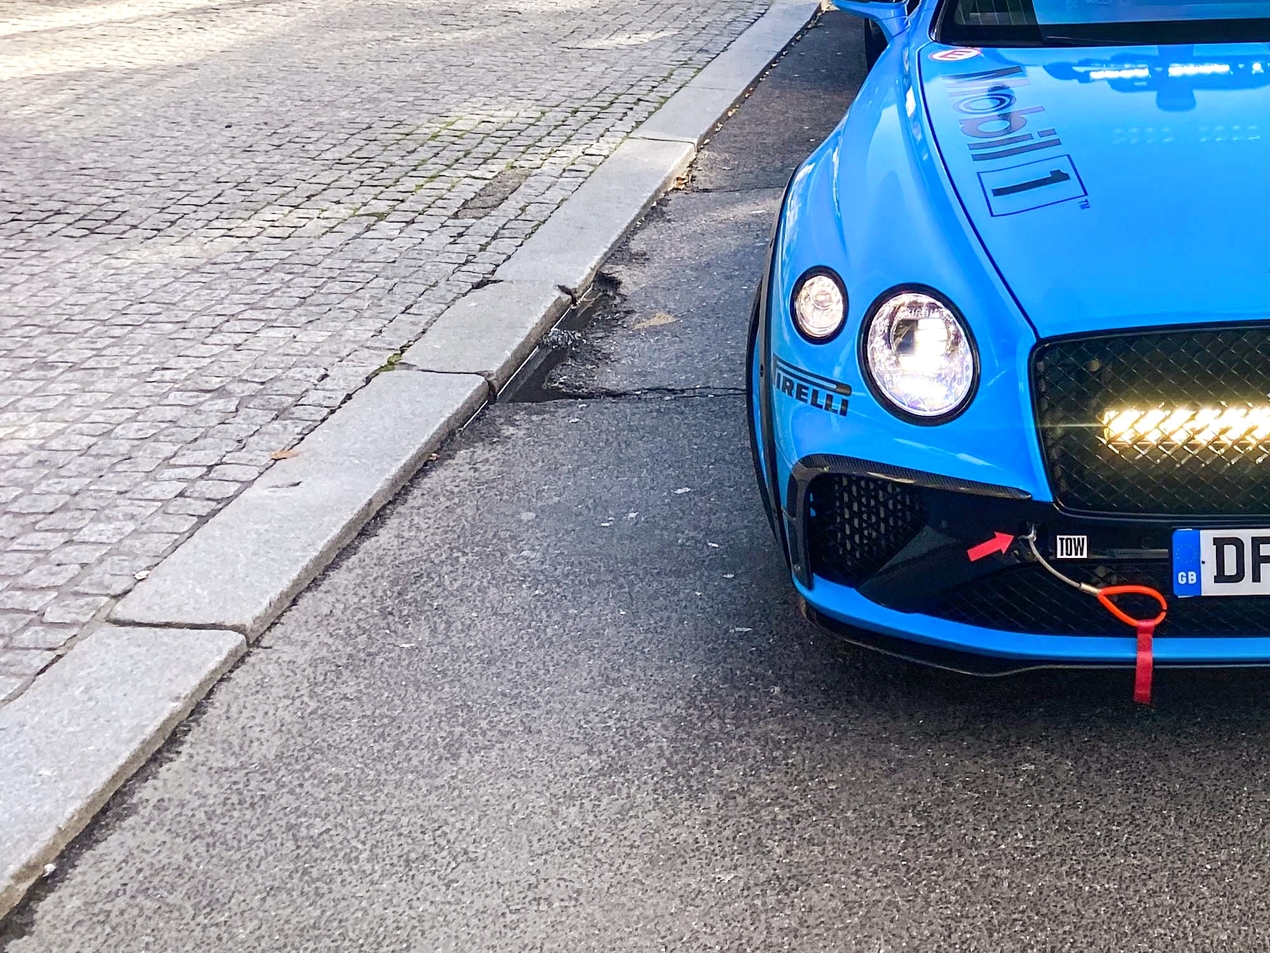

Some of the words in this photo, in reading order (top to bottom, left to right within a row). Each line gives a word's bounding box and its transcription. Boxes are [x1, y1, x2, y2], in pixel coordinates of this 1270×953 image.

[941, 65, 1062, 162] Mobil
[1058, 537, 1085, 557] TOW
[1177, 571, 1197, 585] GB
